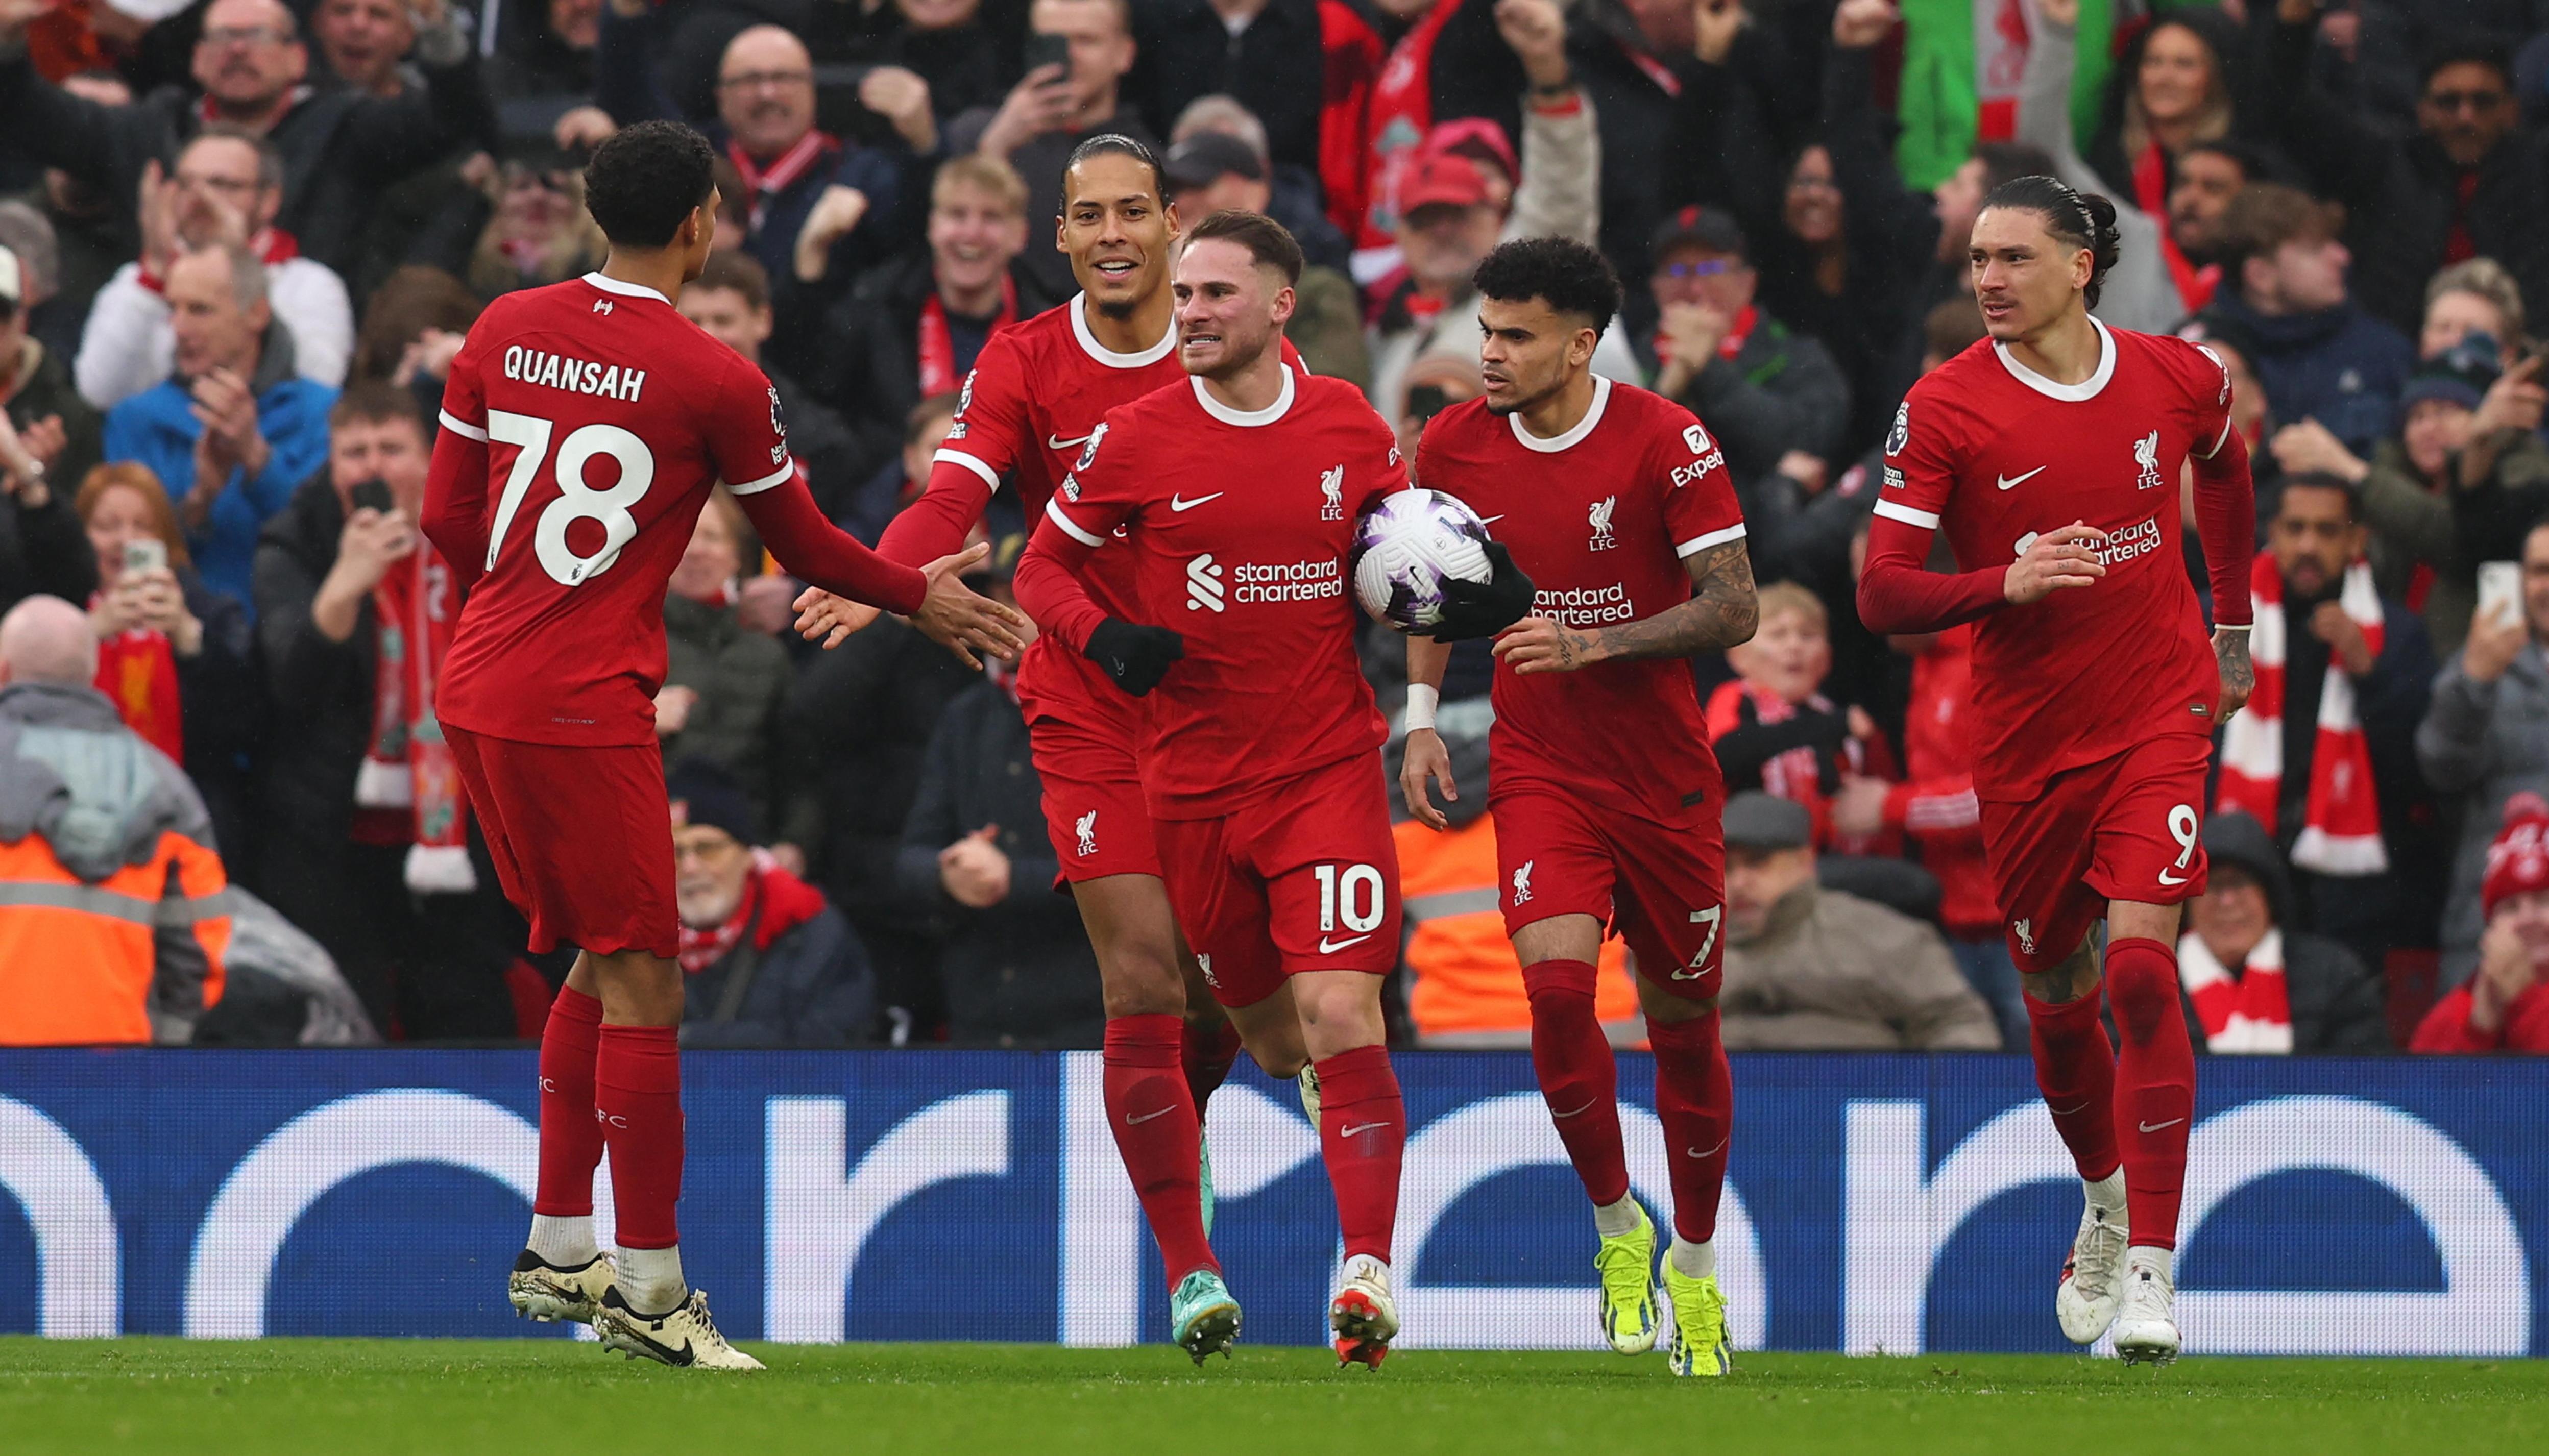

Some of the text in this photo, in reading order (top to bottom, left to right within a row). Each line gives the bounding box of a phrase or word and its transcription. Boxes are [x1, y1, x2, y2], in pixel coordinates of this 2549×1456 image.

[504, 344, 645, 403] QUANSAH
[485, 409, 654, 586] 78
[1234, 556, 1337, 583] standard
[2094, 530, 2162, 566] artered
[1235, 575, 1342, 603] chartered
[1533, 582, 1623, 606] andard
[2167, 803, 2197, 870] 9
[1314, 863, 1385, 933] 10
[1689, 904, 1721, 968] 7
[595, 1108, 627, 1129] FC
